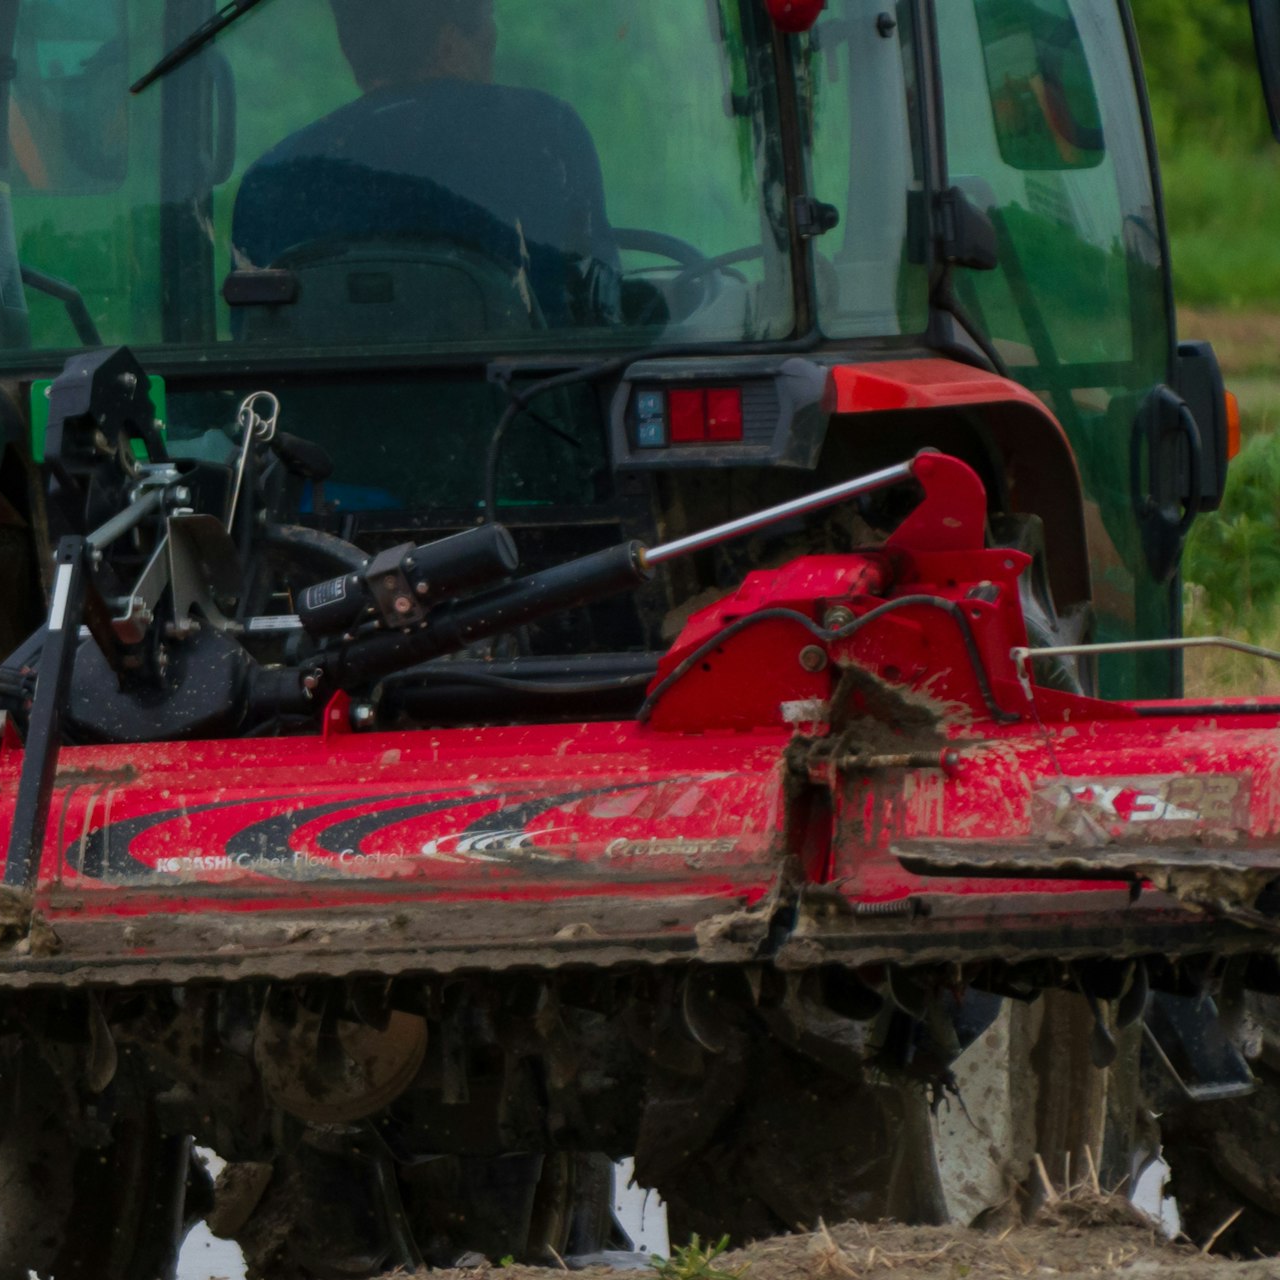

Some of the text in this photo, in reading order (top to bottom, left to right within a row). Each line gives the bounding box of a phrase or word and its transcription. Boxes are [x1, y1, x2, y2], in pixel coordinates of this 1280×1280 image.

[156, 847, 405, 872] KOBASHI Cyber Flow Control
